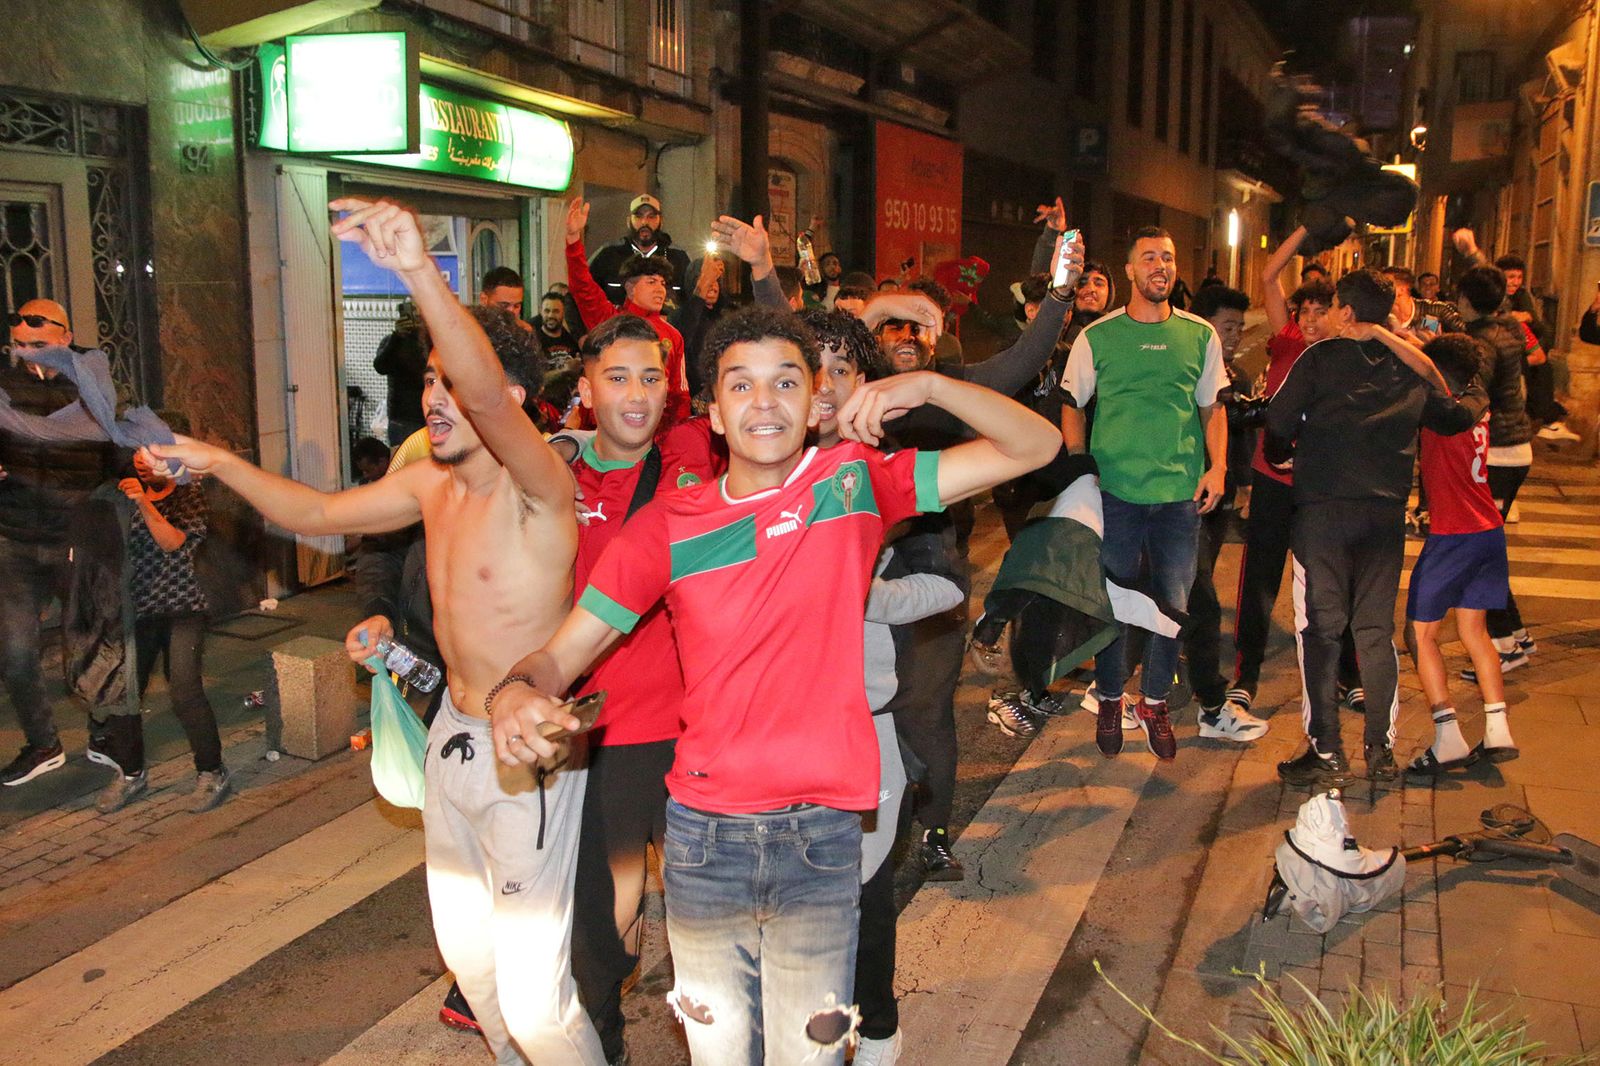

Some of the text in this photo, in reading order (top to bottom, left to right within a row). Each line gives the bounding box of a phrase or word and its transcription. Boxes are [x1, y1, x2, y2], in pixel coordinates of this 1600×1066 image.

[1080, 129, 1099, 152] P
[182, 145, 210, 173] 94
[885, 199, 957, 234] 950 10 93 15
[765, 520, 798, 539] PUMA
[505, 880, 523, 891] NIKE
